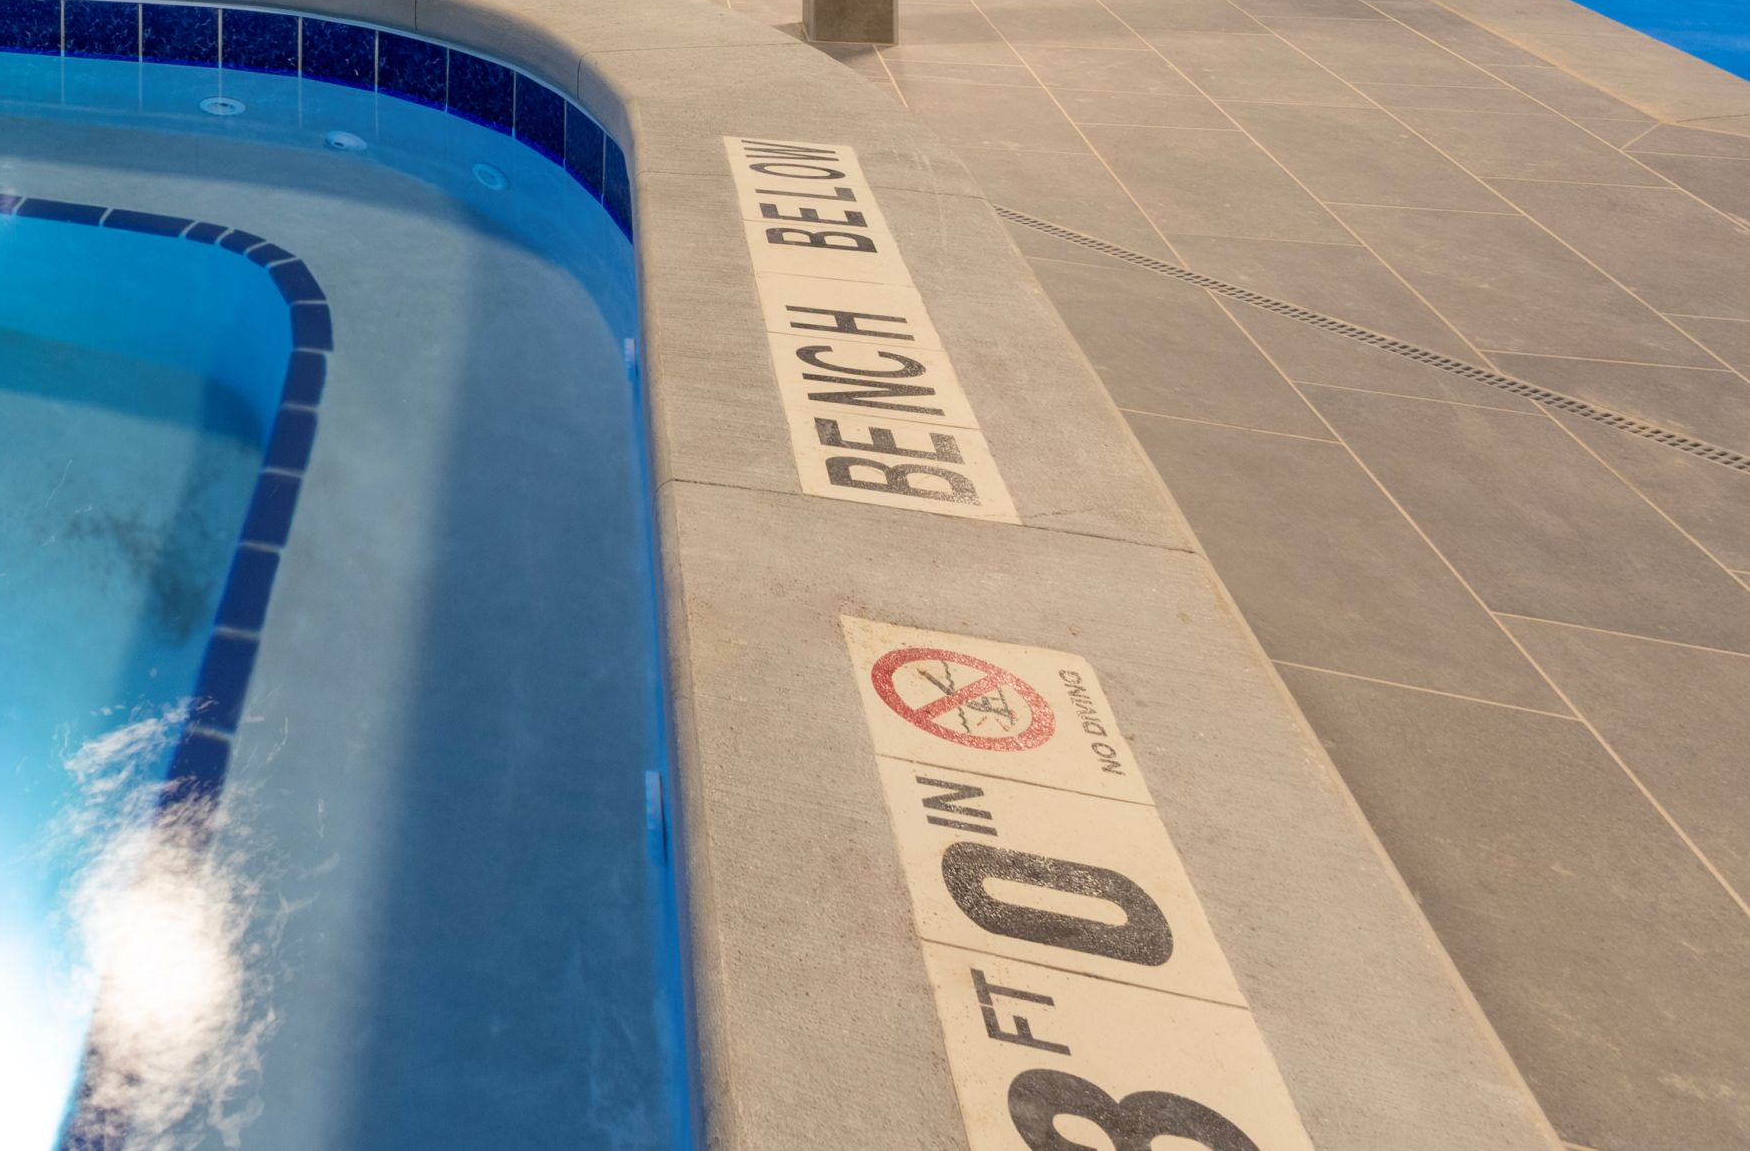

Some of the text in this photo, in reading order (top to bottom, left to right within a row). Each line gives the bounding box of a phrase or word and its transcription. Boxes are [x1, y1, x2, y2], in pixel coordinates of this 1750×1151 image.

[741, 139, 982, 506] BENCH BELOW
[1058, 669, 1126, 776] NO DIVING
[915, 775, 998, 836] IN
[970, 968, 1071, 1056] FT
